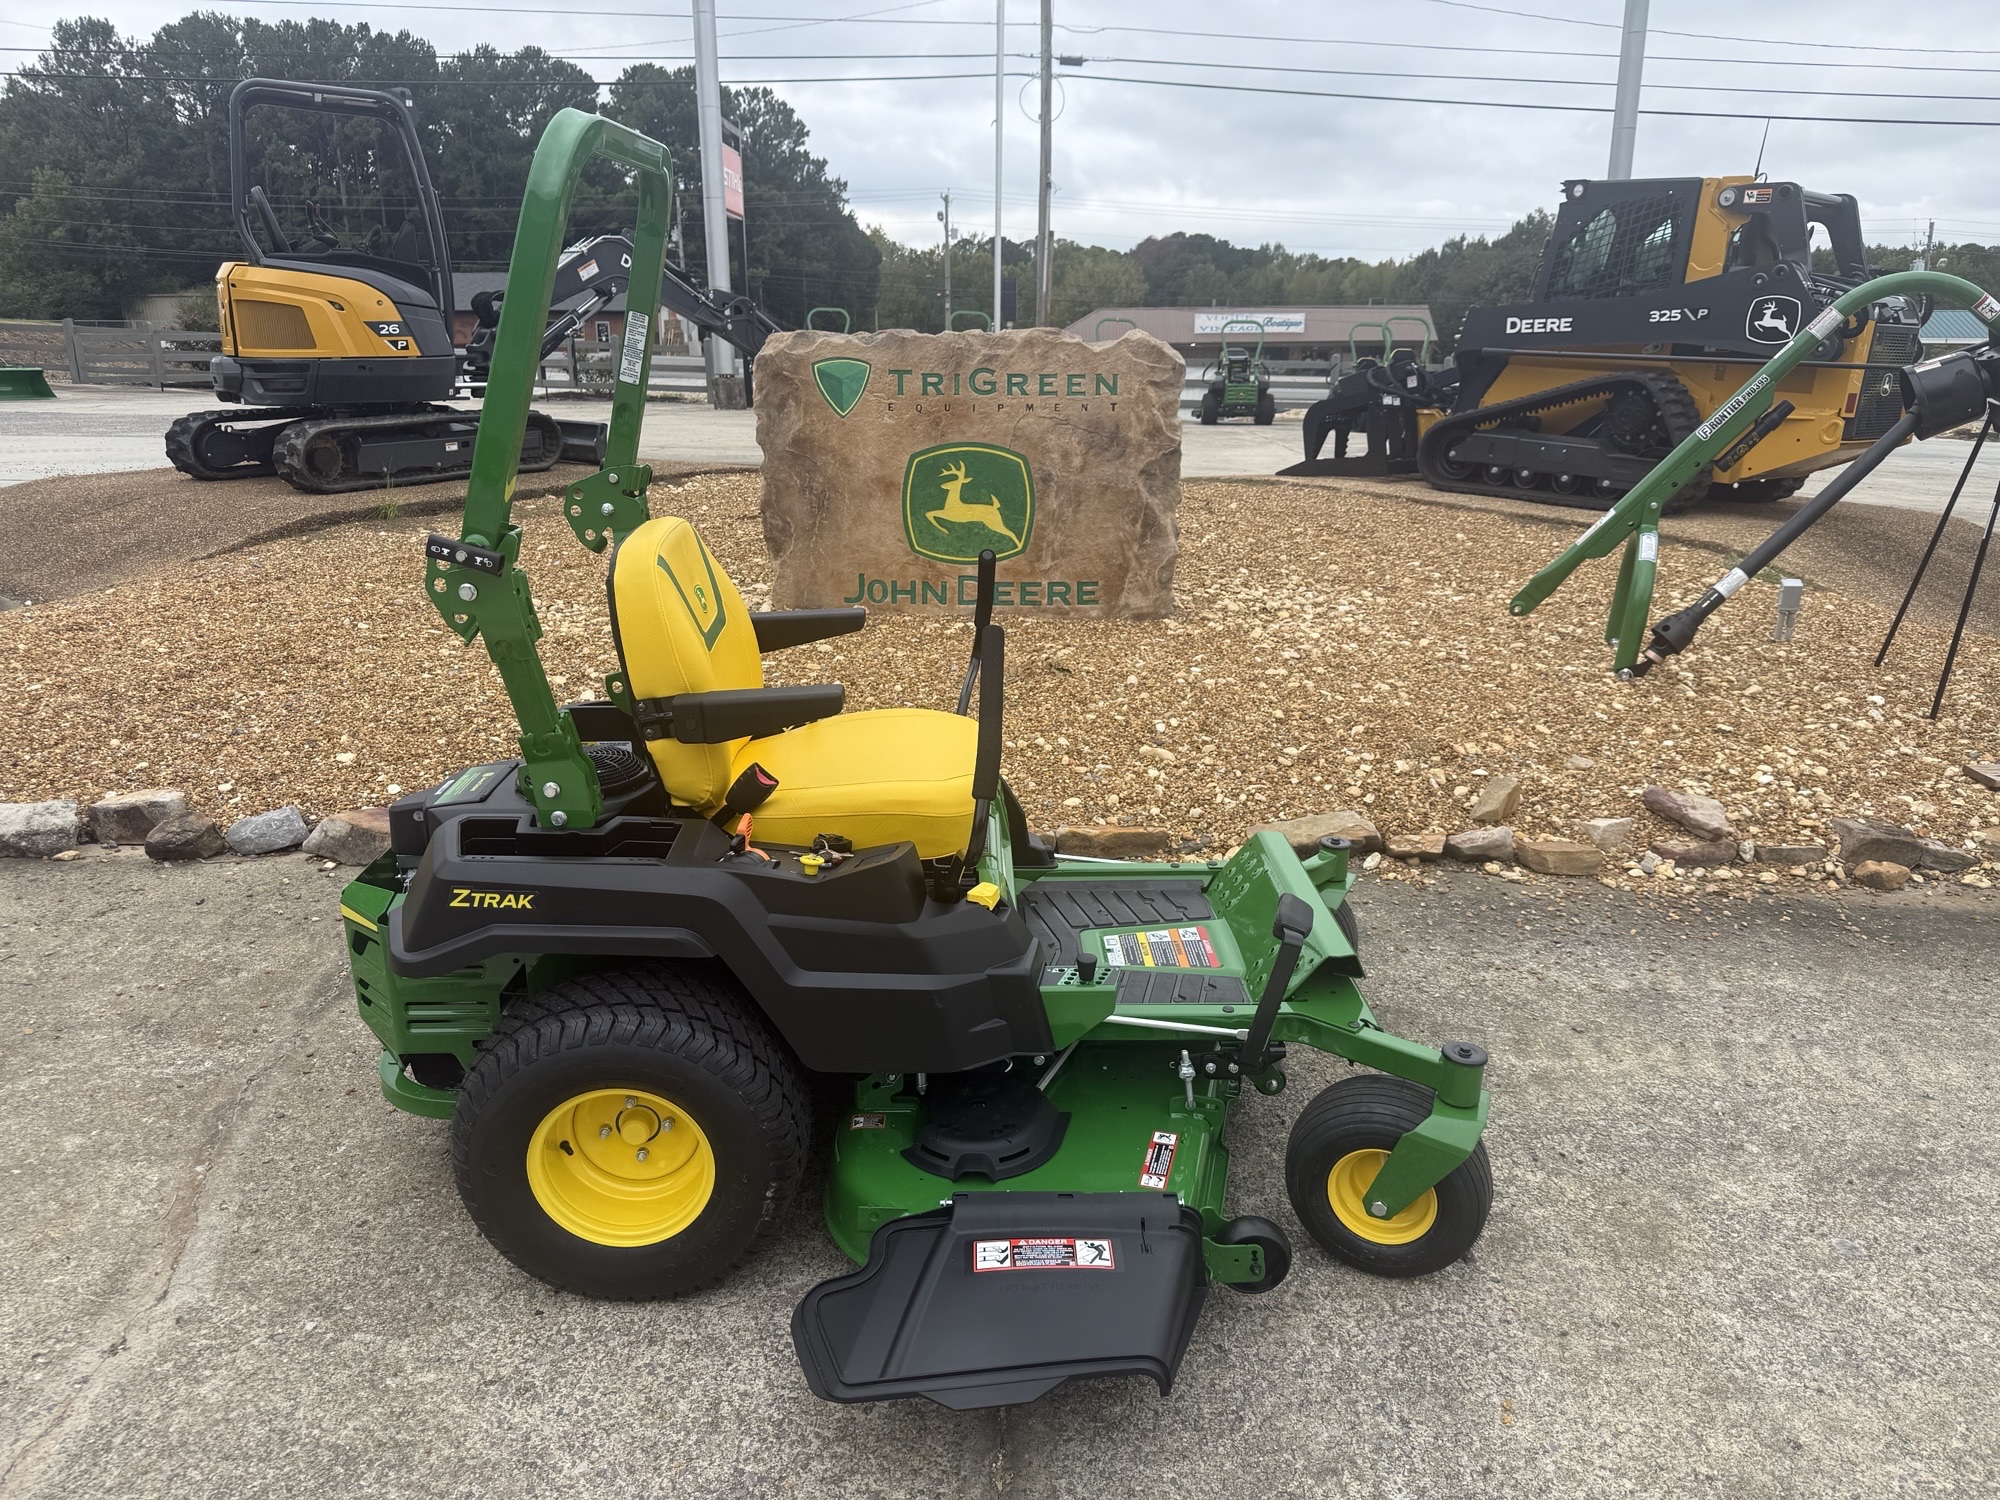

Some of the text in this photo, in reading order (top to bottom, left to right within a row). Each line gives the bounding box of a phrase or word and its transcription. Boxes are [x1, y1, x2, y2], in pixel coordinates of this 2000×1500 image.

[1262, 316, 1303, 330] Boutique
[1648, 309, 1682, 323] 325
[378, 324, 400, 335] 26
[1505, 316, 1574, 335] DEERE
[397, 340, 407, 350] P
[887, 402, 1118, 413] EQUIPMENT
[1697, 374, 1770, 440] FRONTIER PHD395
[843, 573, 1099, 606] JOHN DEERE
[449, 888, 534, 909] ZTRAK
